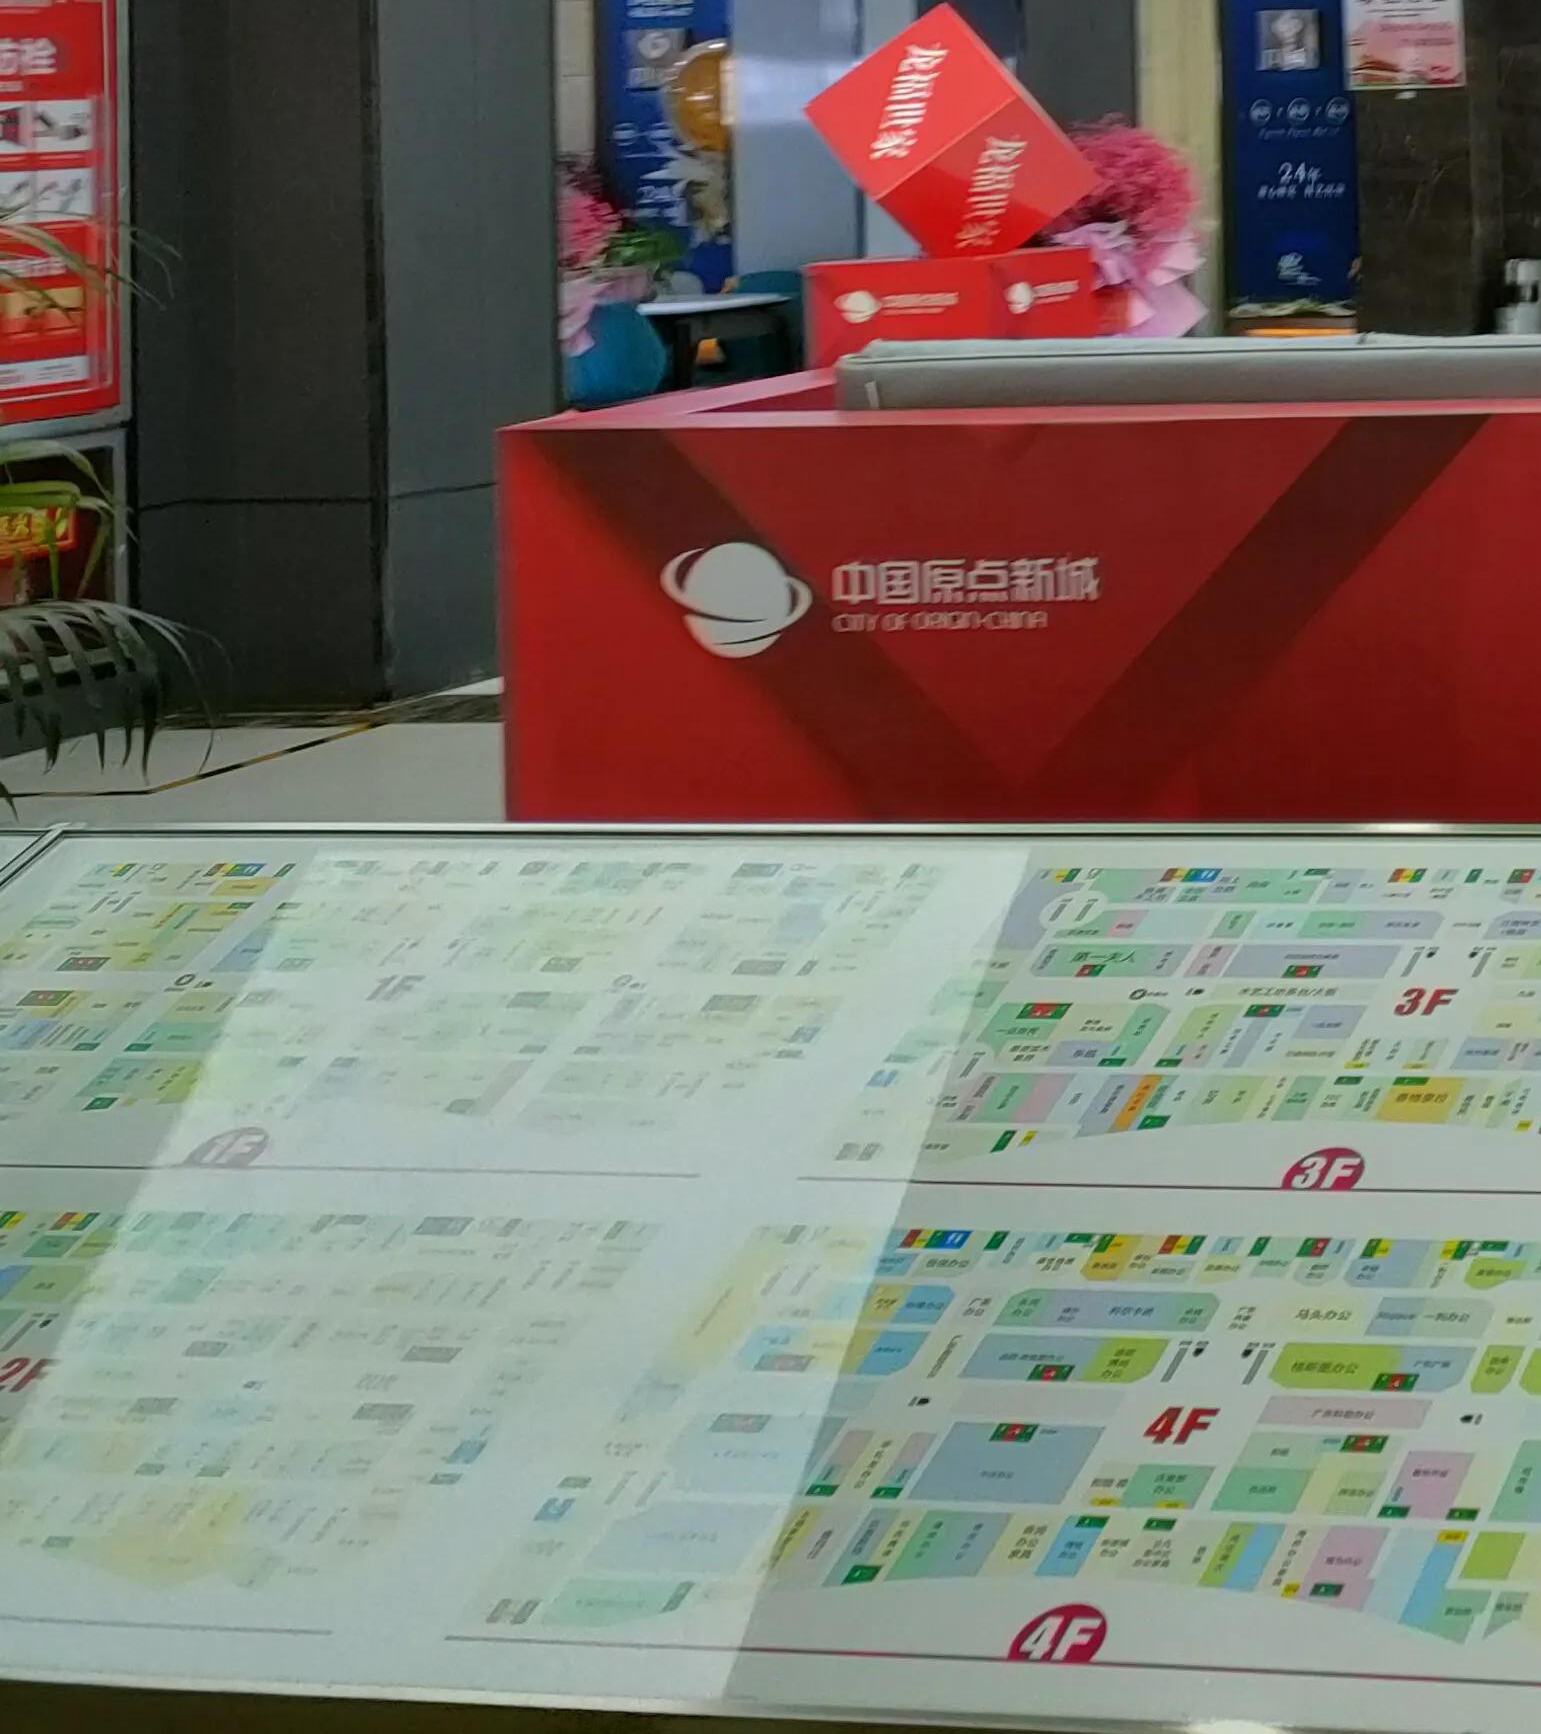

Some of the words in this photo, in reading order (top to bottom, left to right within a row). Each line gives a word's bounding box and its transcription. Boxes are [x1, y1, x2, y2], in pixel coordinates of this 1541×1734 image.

[831, 555, 1100, 605] 中国原点新城
[1393, 987, 1459, 1017] 3F
[1290, 1155, 1364, 1190] 3F
[1142, 1405, 1221, 1445] 4F
[1019, 1615, 1104, 1661] 4F
